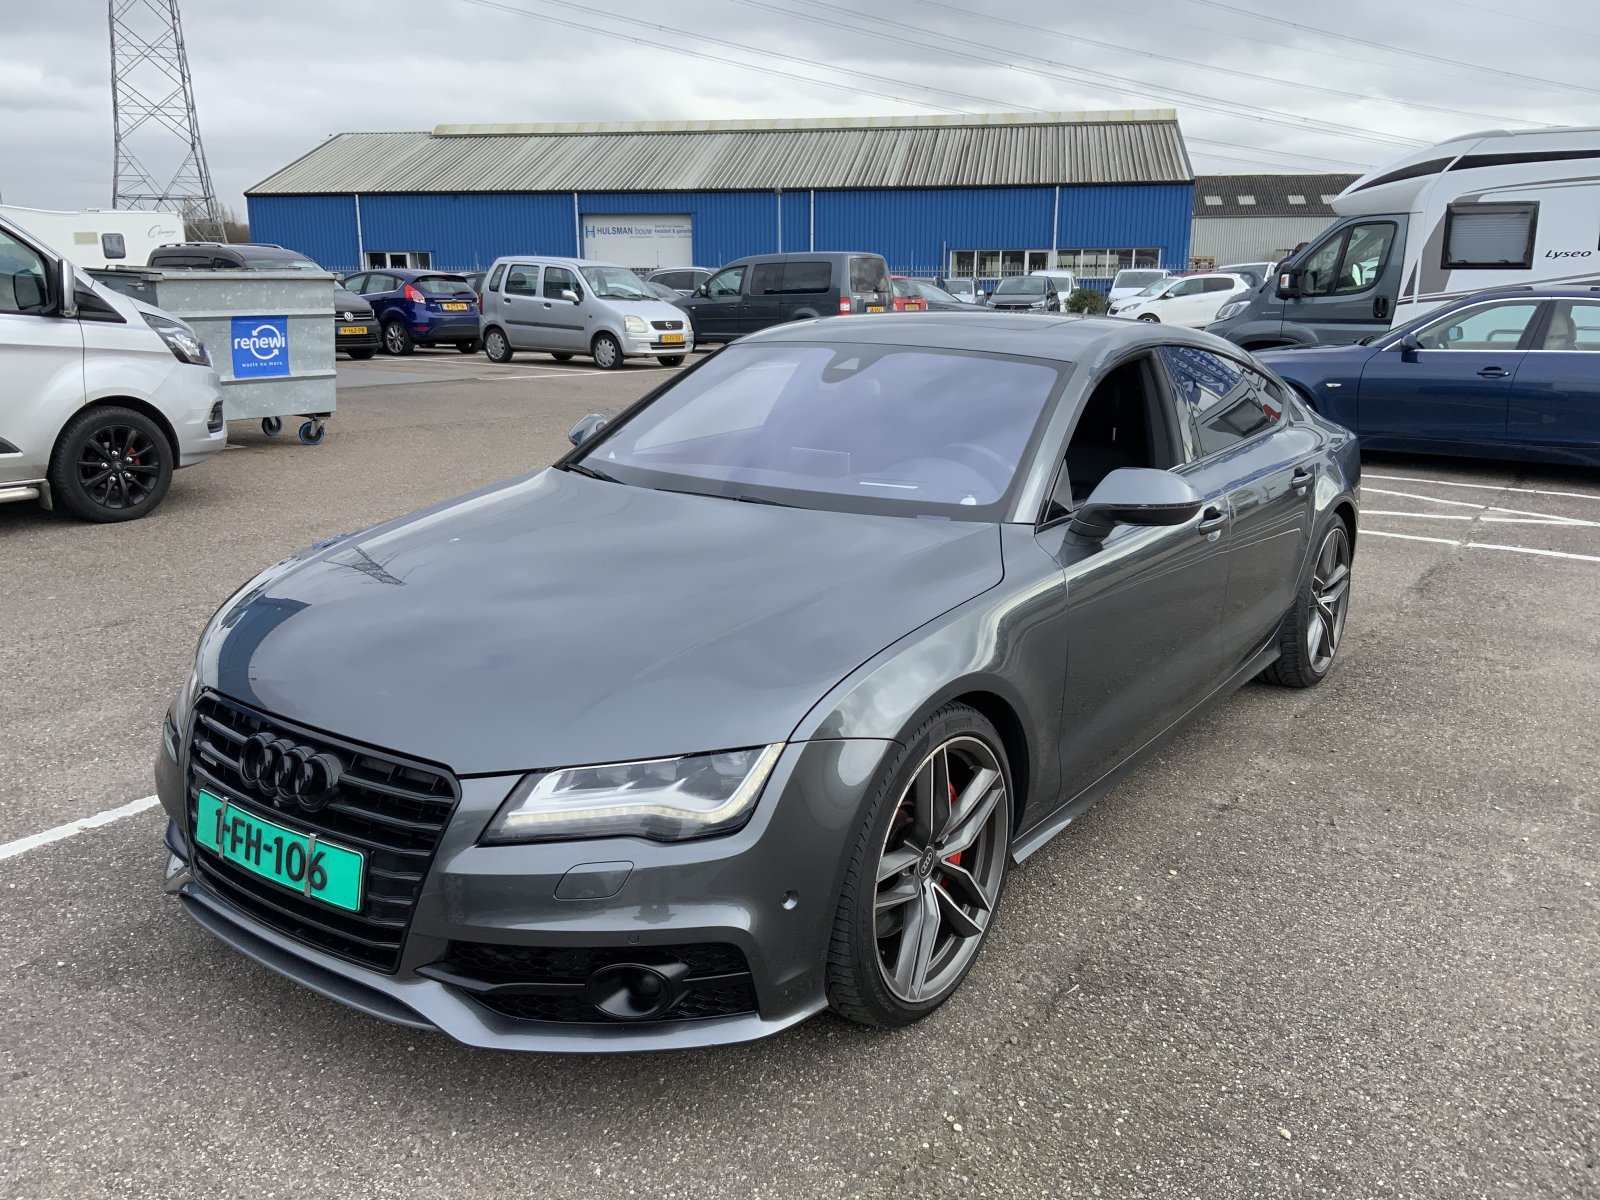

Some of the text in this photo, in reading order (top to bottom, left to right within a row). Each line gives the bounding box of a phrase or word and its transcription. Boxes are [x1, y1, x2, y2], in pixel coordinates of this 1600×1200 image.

[597, 226, 633, 235] HULSMAN
[634, 227, 653, 235] bouw
[1545, 250, 1592, 259] Lyseo
[234, 332, 286, 350] renewi
